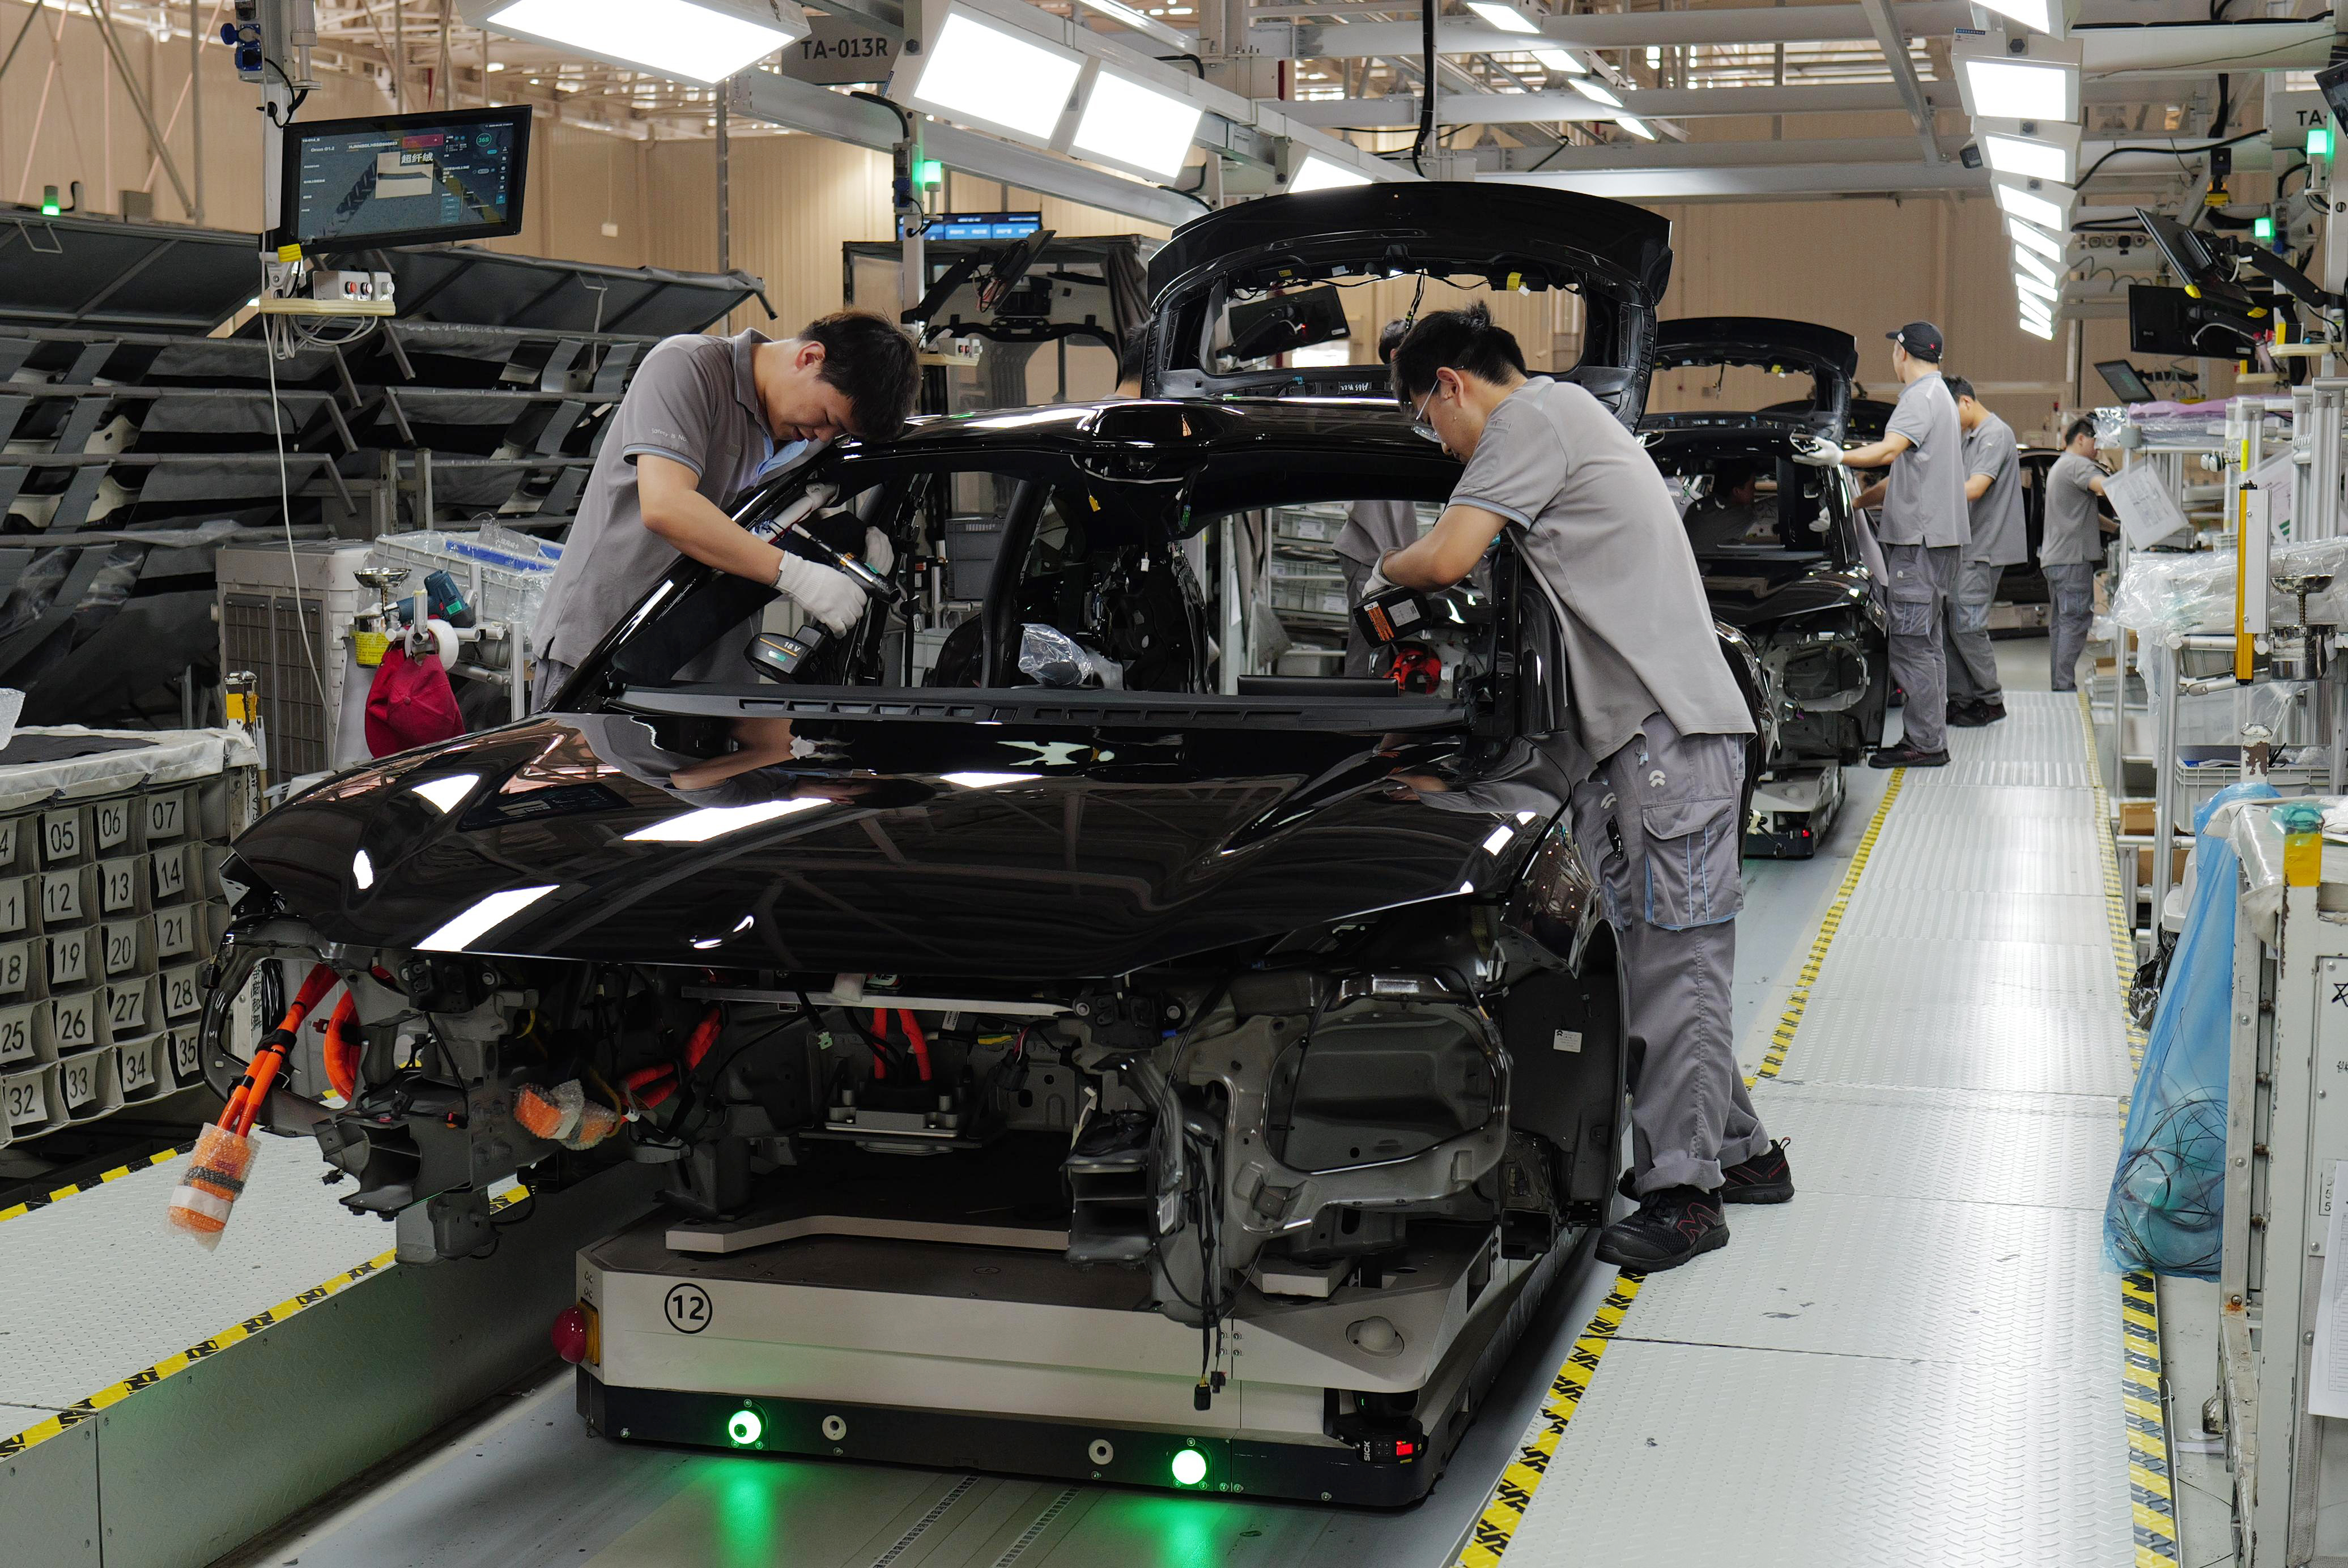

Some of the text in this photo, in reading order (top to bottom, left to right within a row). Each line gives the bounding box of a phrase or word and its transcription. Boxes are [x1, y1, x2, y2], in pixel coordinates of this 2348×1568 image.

[800, 37, 888, 59] TA-013R
[401, 152, 434, 164] 超纤绒
[651, 428, 669, 437] Safety
[784, 641, 794, 650] 18
[103, 807, 120, 837] 06
[152, 801, 176, 830] 07
[50, 821, 74, 853] 05
[110, 872, 129, 903] 13
[161, 857, 181, 889] 14
[0, 896, 15, 926] 1
[48, 883, 72, 913] 12
[164, 917, 183, 948] 21
[60, 943, 80, 974] 19
[110, 936, 131, 966] 20
[0, 955, 21, 987] 18
[114, 992, 140, 1022] 27
[172, 979, 193, 1010] 28
[2, 1020, 24, 1054] 25
[61, 1009, 86, 1040] 26
[179, 1036, 197, 1067] 35
[69, 1067, 87, 1099] 33
[126, 1051, 146, 1084] 34
[10, 1084, 35, 1117] 32
[673, 1294, 704, 1320] 12
